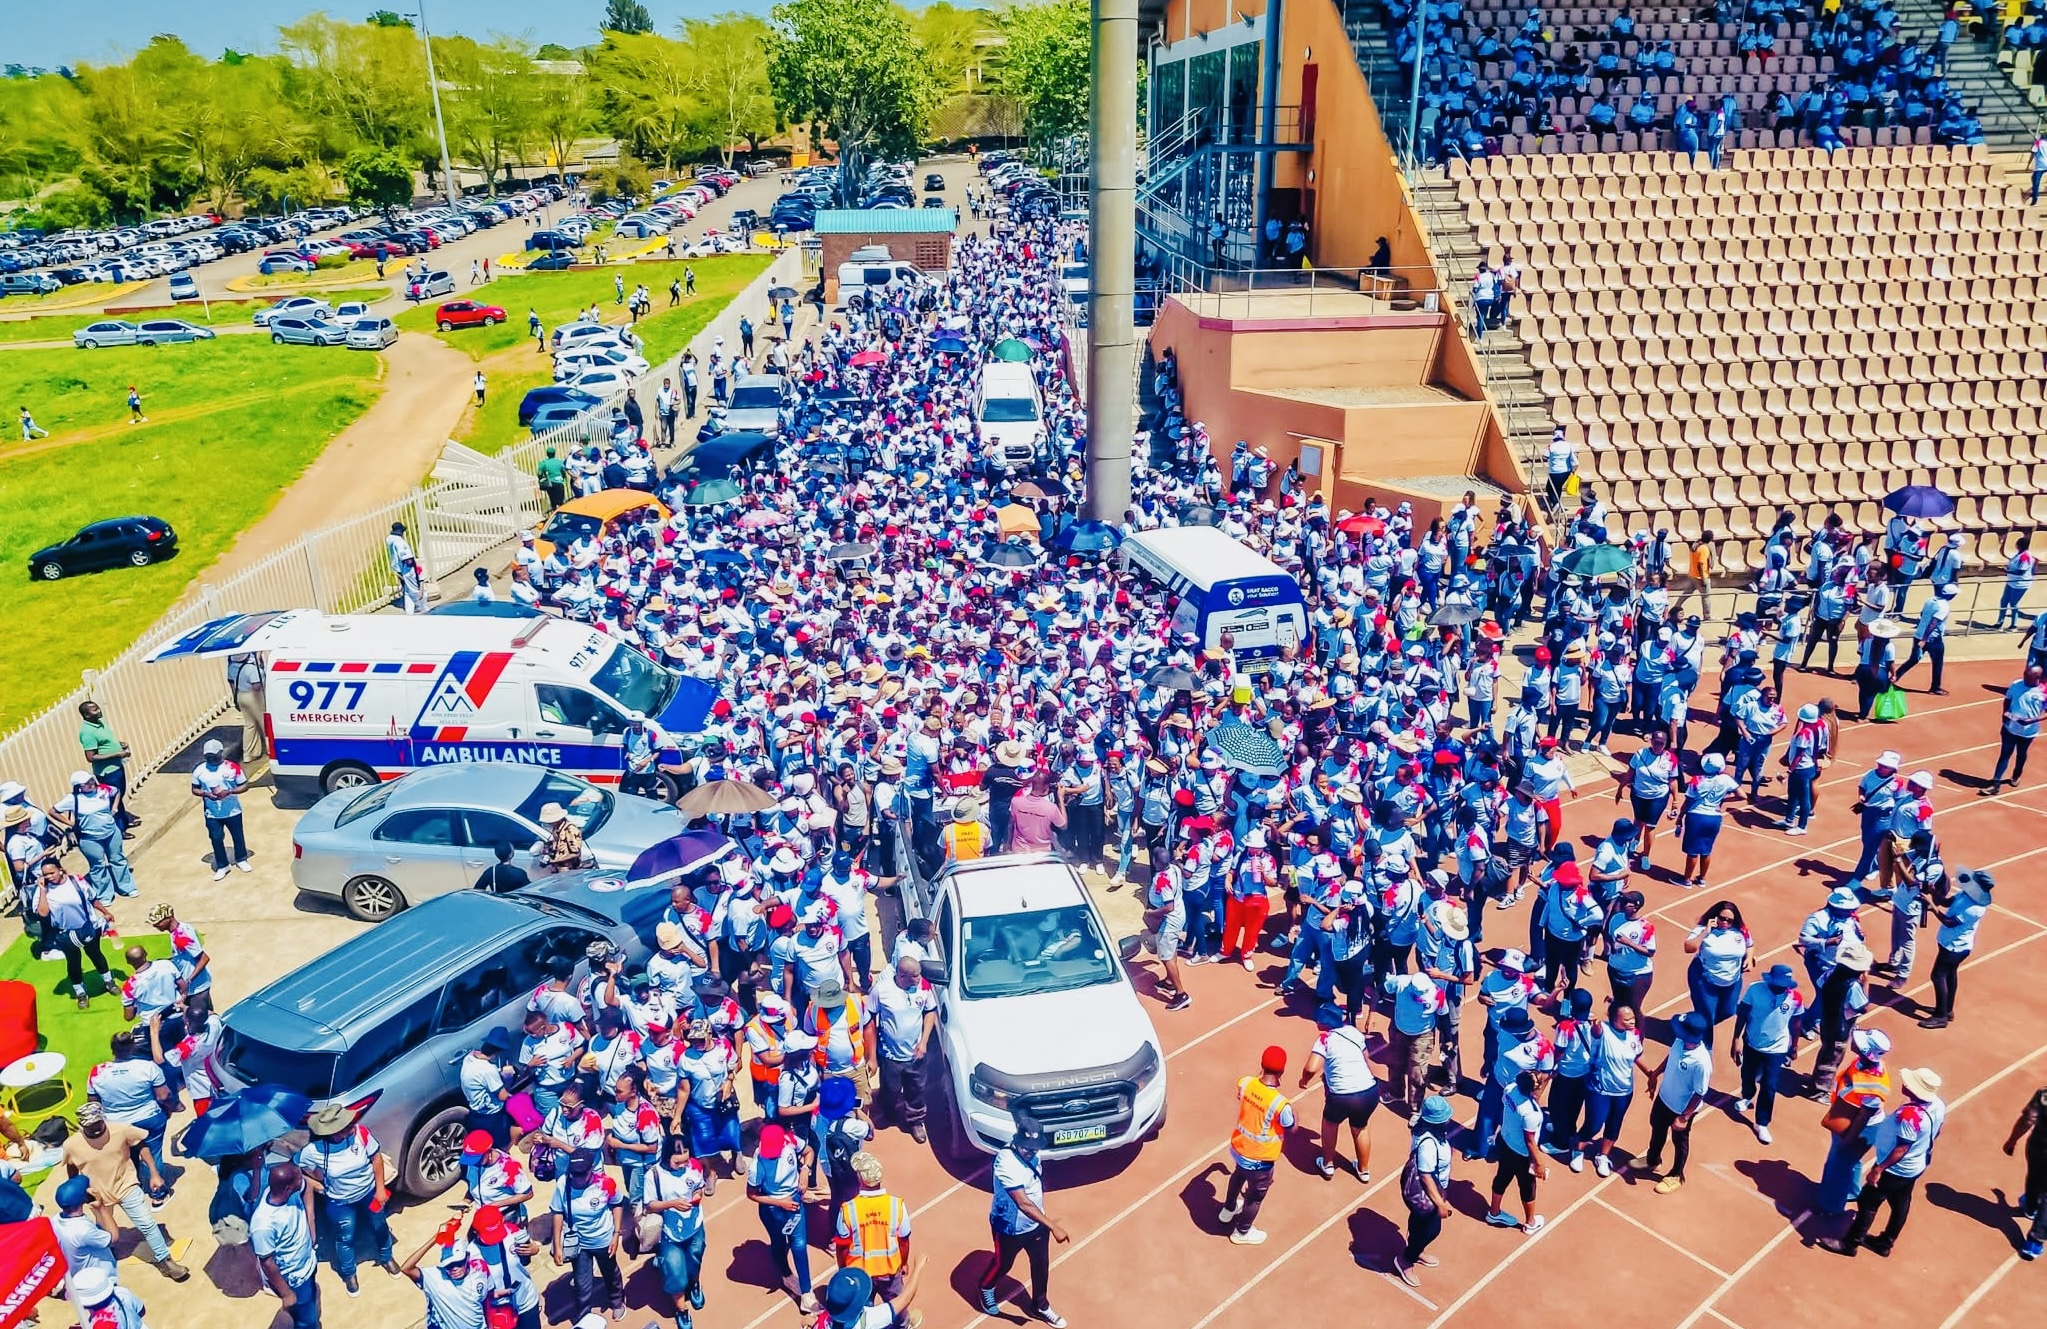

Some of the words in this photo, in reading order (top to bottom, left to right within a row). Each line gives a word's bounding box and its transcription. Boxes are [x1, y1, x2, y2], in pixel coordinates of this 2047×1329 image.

[569, 651, 588, 669] 977
[289, 680, 368, 710] 977
[290, 713, 365, 723] EMERGENCY
[421, 746, 562, 765] AMBULANCE
[1031, 1069, 1118, 1090] RANGER
[1056, 1132, 1073, 1141] WSD
[1073, 1129, 1089, 1139] 707
[1094, 1126, 1106, 1136] CH
